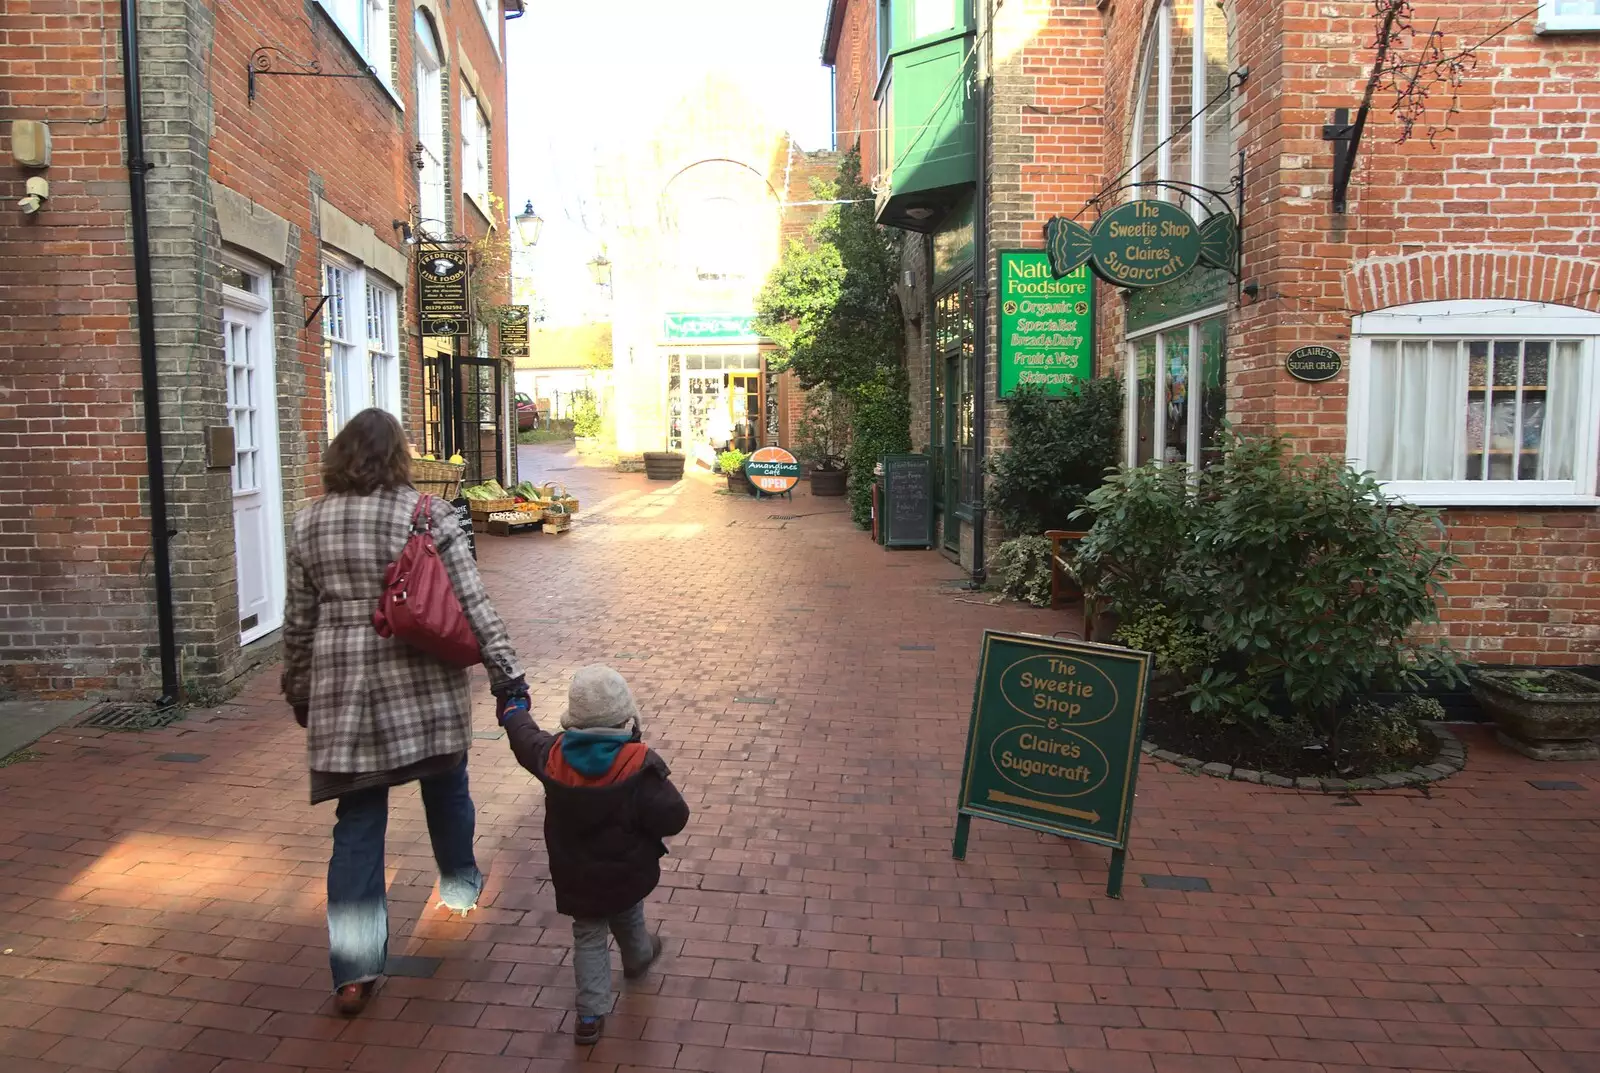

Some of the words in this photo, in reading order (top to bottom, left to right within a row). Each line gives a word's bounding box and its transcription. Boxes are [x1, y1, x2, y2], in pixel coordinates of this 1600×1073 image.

[1134, 202, 1160, 218] The
[1109, 221, 1157, 238] Sweetie
[1160, 221, 1190, 239] Shop
[422, 253, 463, 265] FREDRICKS
[1125, 246, 1170, 261] Claire's
[1008, 260, 1086, 278] Natual
[1103, 251, 1185, 281] Sugarcraft
[422, 271, 438, 281] FINE
[441, 270, 463, 281] FOODS
[1008, 280, 1086, 294] Foodstore
[1019, 300, 1072, 316] Organic
[1016, 318, 1077, 333] Specialist
[1010, 333, 1046, 347] Bread
[1052, 334, 1083, 348] Dairy
[1014, 352, 1045, 364] Fruit
[1045, 357, 1054, 365] &
[1055, 352, 1079, 368] Veg
[1296, 348, 1334, 359] CLAIRE'S
[1289, 361, 1315, 370] SUGAR
[1315, 361, 1340, 370] CRAFT
[1018, 370, 1074, 384] Skincare
[748, 462, 797, 470] Amandines
[761, 478, 786, 488] OPEN
[1048, 659, 1077, 676] The
[1019, 672, 1094, 698] Sweetie
[1033, 693, 1081, 719] Shop
[1047, 717, 1060, 730] &
[1019, 733, 1081, 759] Claire's
[1001, 750, 1091, 784] Sugarcraft
